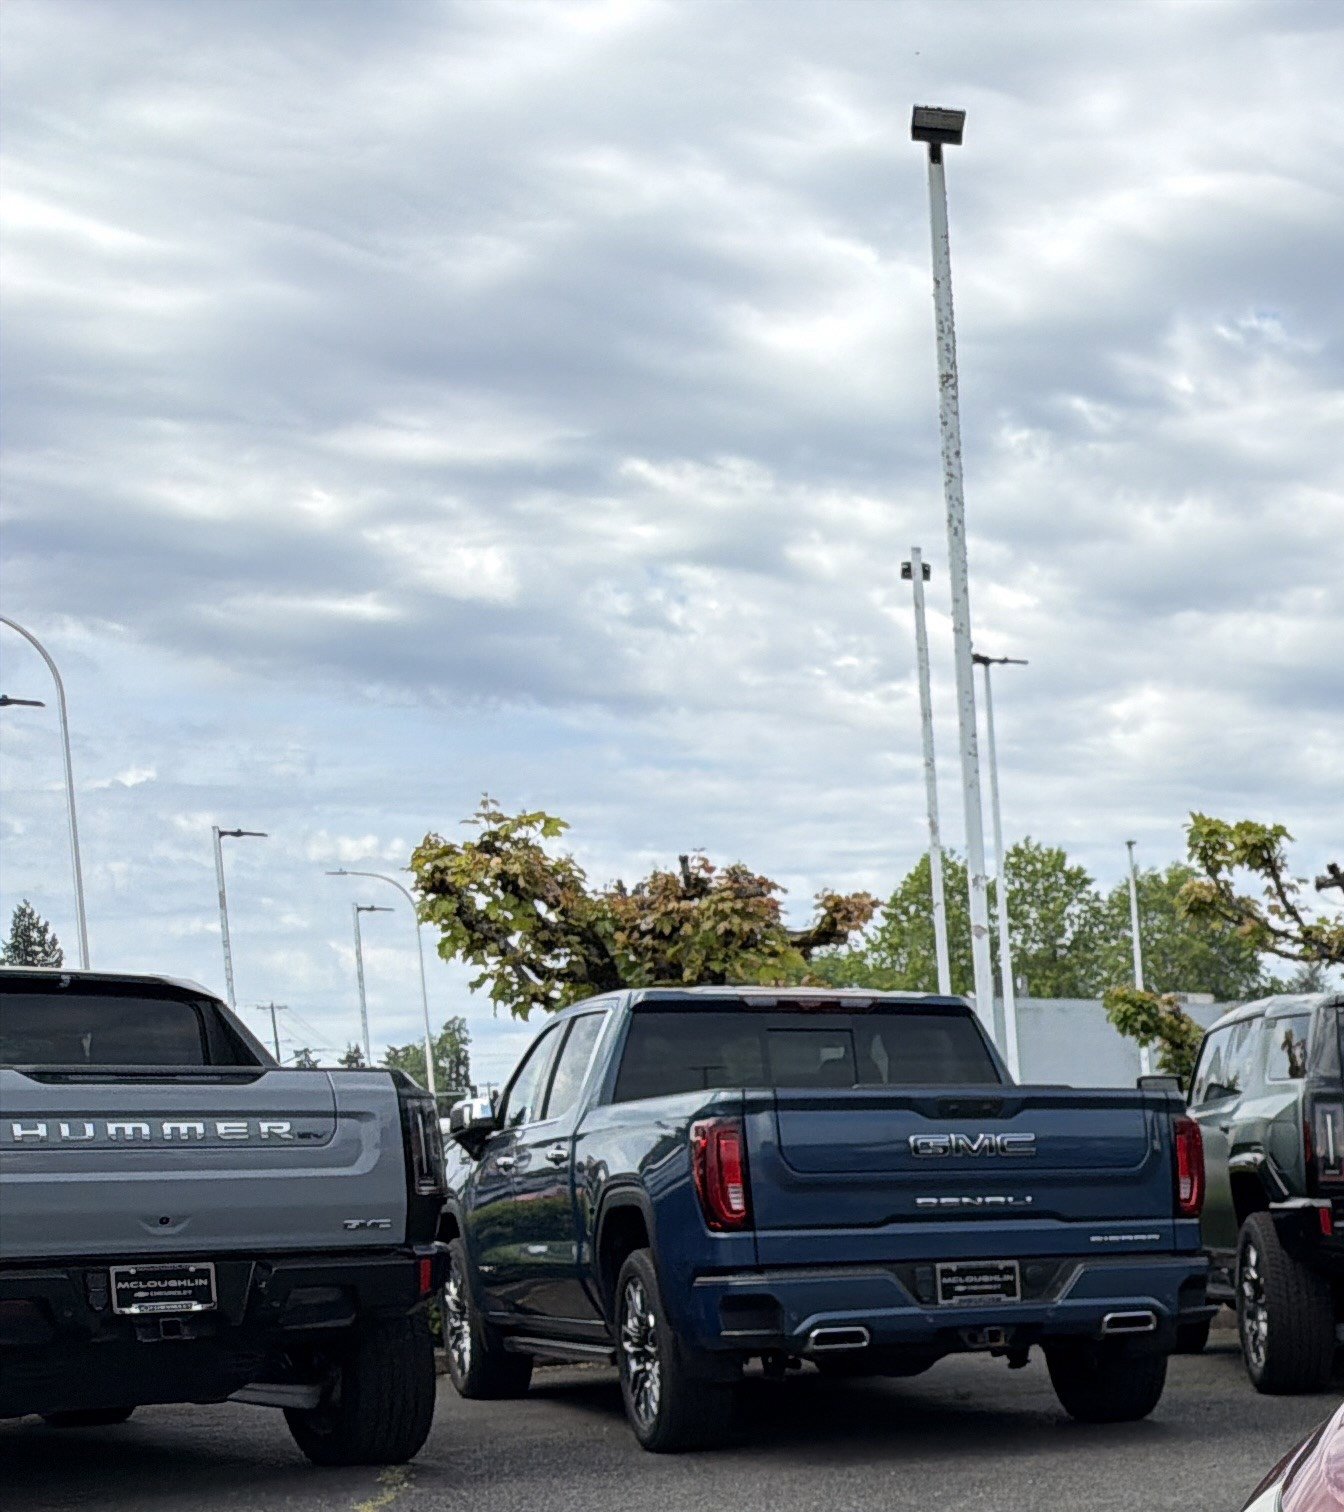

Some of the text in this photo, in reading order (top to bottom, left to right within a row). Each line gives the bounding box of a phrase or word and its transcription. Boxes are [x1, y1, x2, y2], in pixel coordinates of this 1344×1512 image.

[11, 1121, 294, 1141] HUMMER
[909, 1132, 1037, 1157] GMC
[117, 1278, 208, 1289] MCLOUGHLIN
